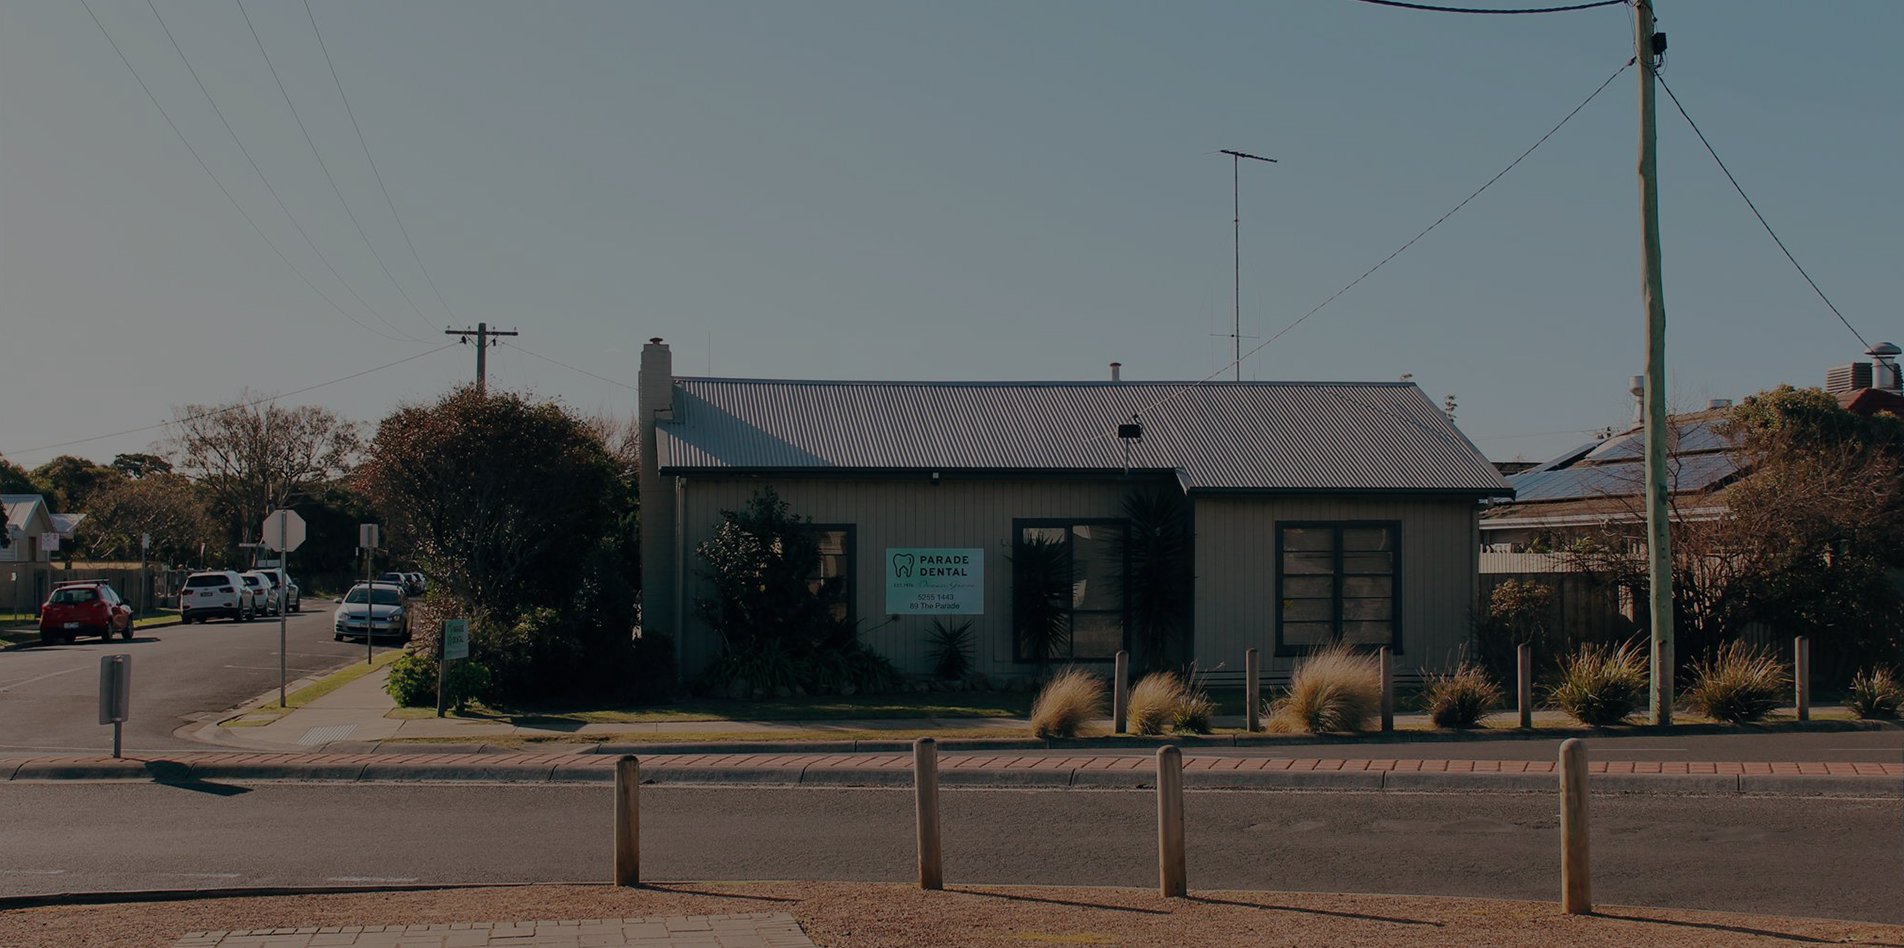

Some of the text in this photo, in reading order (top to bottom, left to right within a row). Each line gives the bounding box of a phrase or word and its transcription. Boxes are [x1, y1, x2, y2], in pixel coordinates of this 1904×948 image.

[920, 555, 969, 564] PARADE
[920, 567, 968, 577] DENTAL
[920, 602, 934, 610] The
[935, 602, 960, 610] Parade
